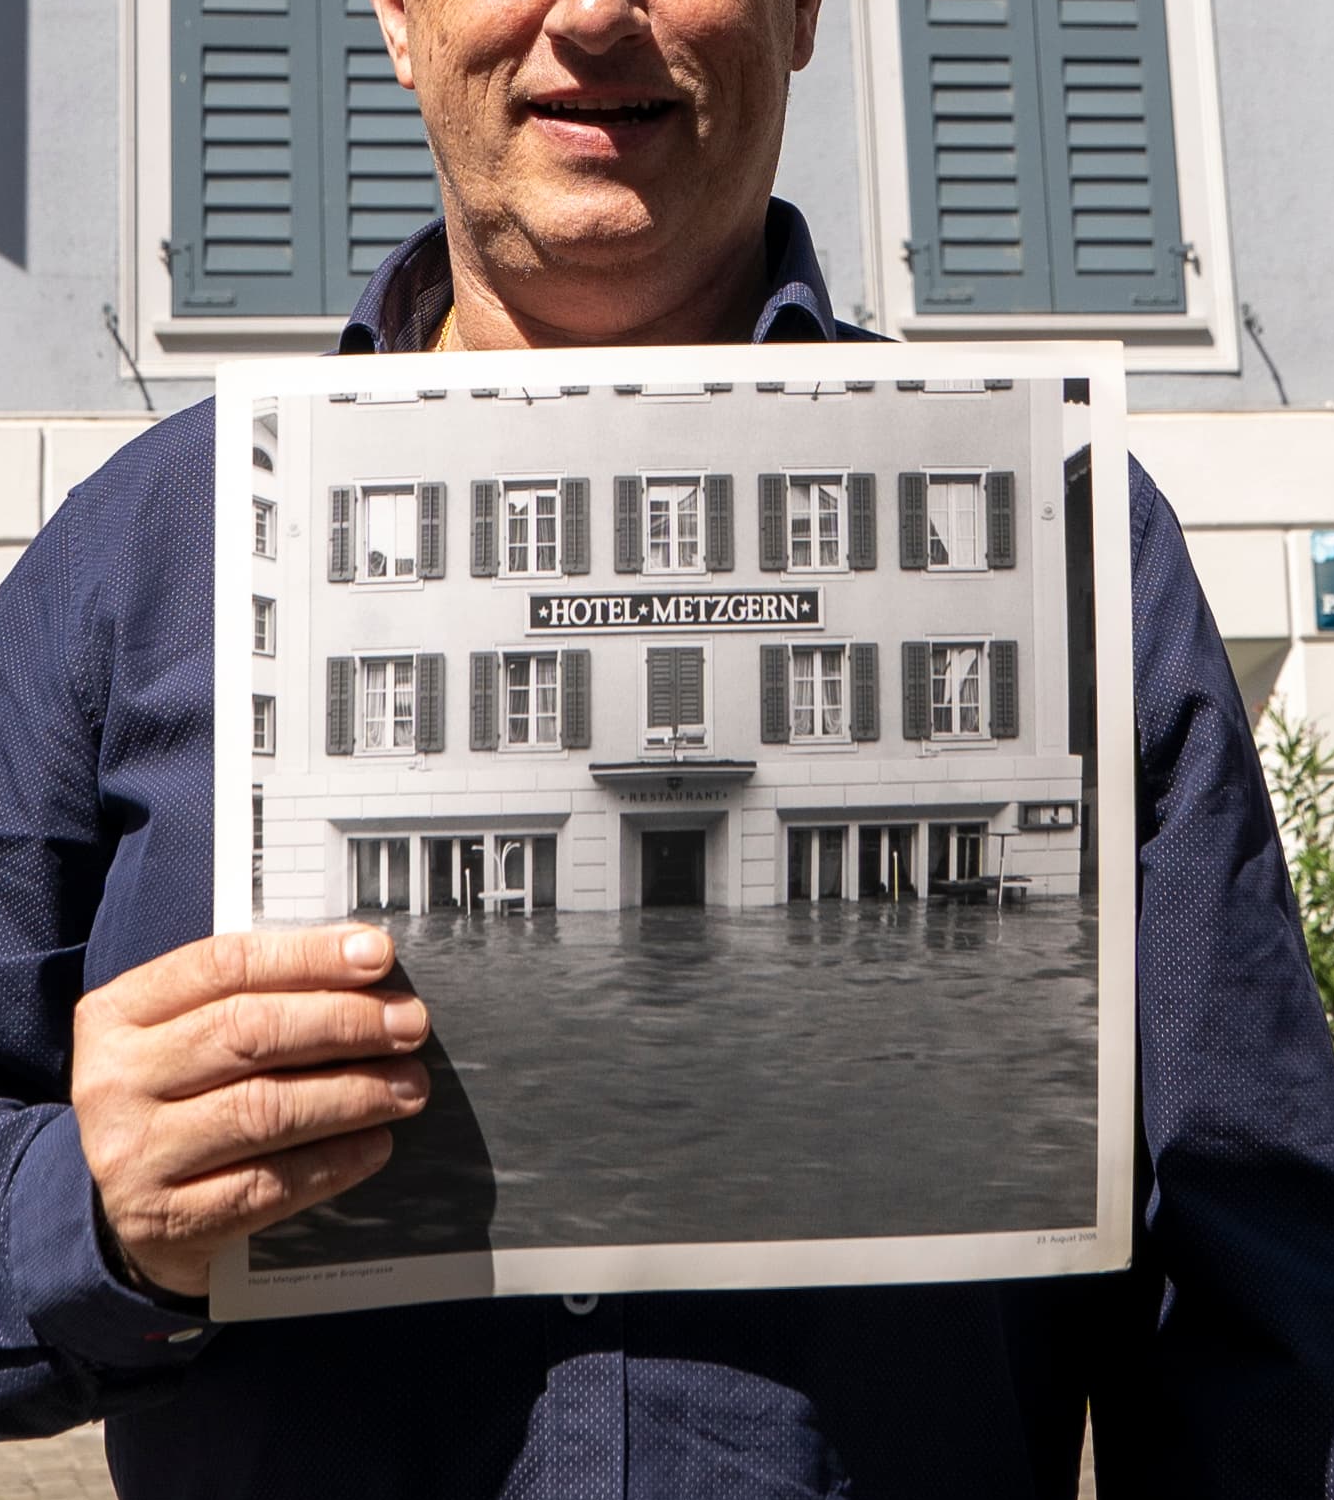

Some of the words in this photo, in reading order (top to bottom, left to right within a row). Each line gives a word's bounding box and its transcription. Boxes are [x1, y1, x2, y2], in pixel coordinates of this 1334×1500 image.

[549, 597, 640, 625] HOTEL
[651, 594, 800, 623] METZGERN
[629, 791, 722, 804] RESTAURANT
